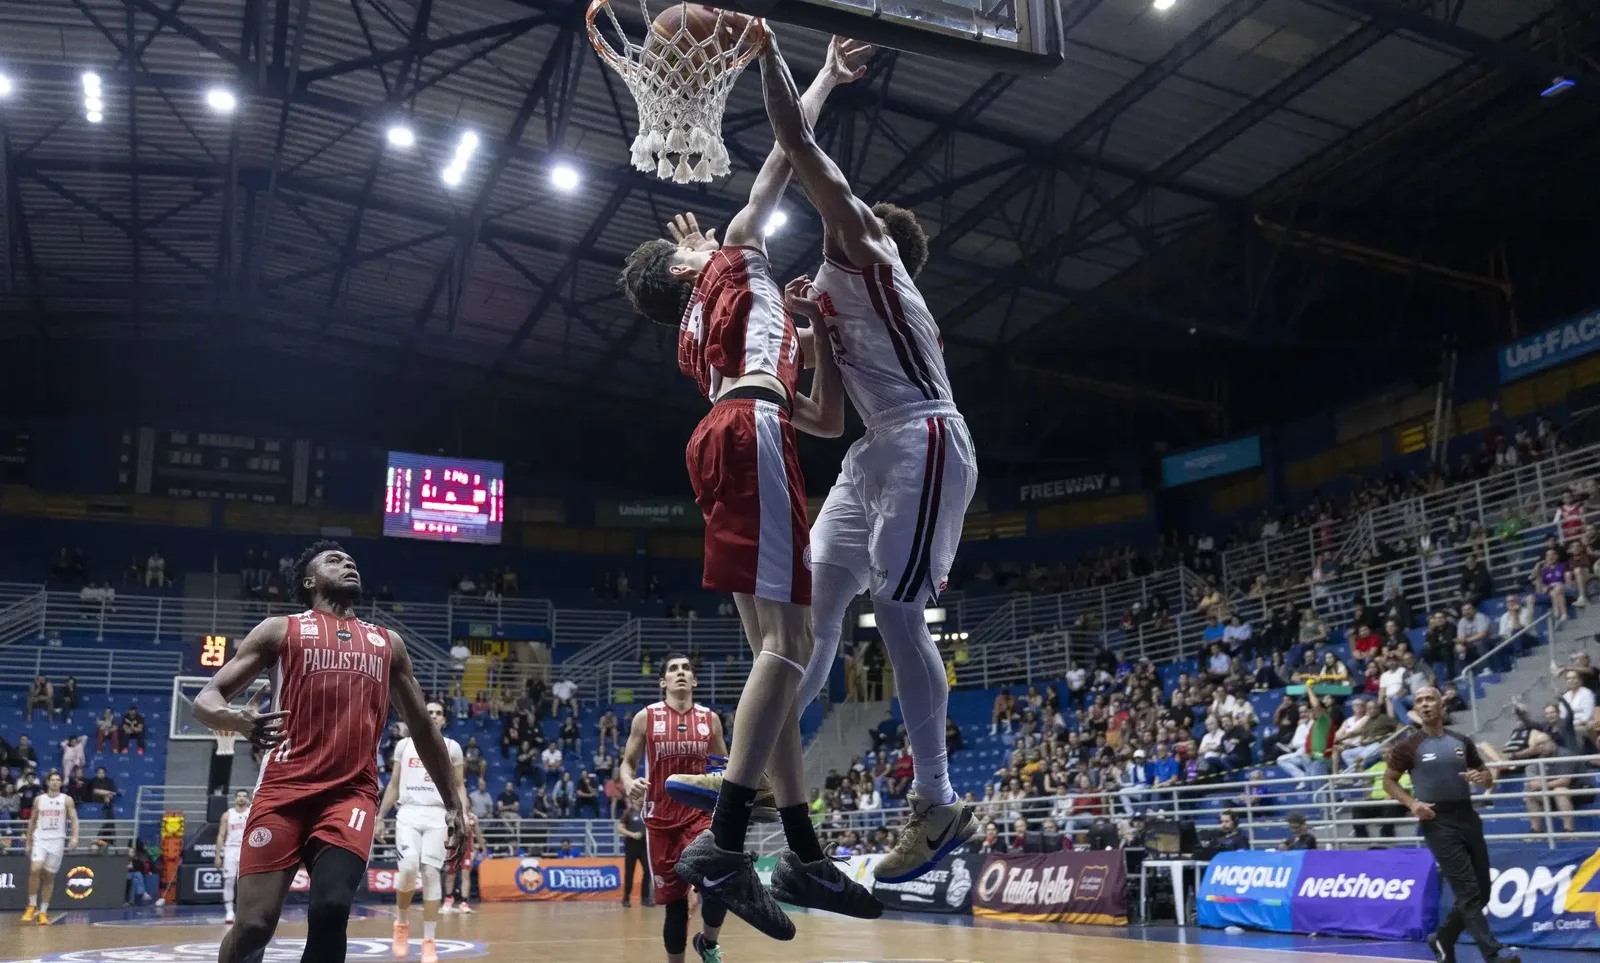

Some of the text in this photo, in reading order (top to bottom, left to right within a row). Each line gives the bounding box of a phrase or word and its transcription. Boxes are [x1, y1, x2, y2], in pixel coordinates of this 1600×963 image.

[1020, 473, 1106, 501] FREEWAY
[302, 648, 384, 684] PAULISTANO
[347, 807, 367, 832] 11
[203, 872, 222, 883] Q2
[549, 868, 617, 889] Daiana
[1298, 873, 1416, 900] Netshoes
[1556, 918, 1592, 931] Center
